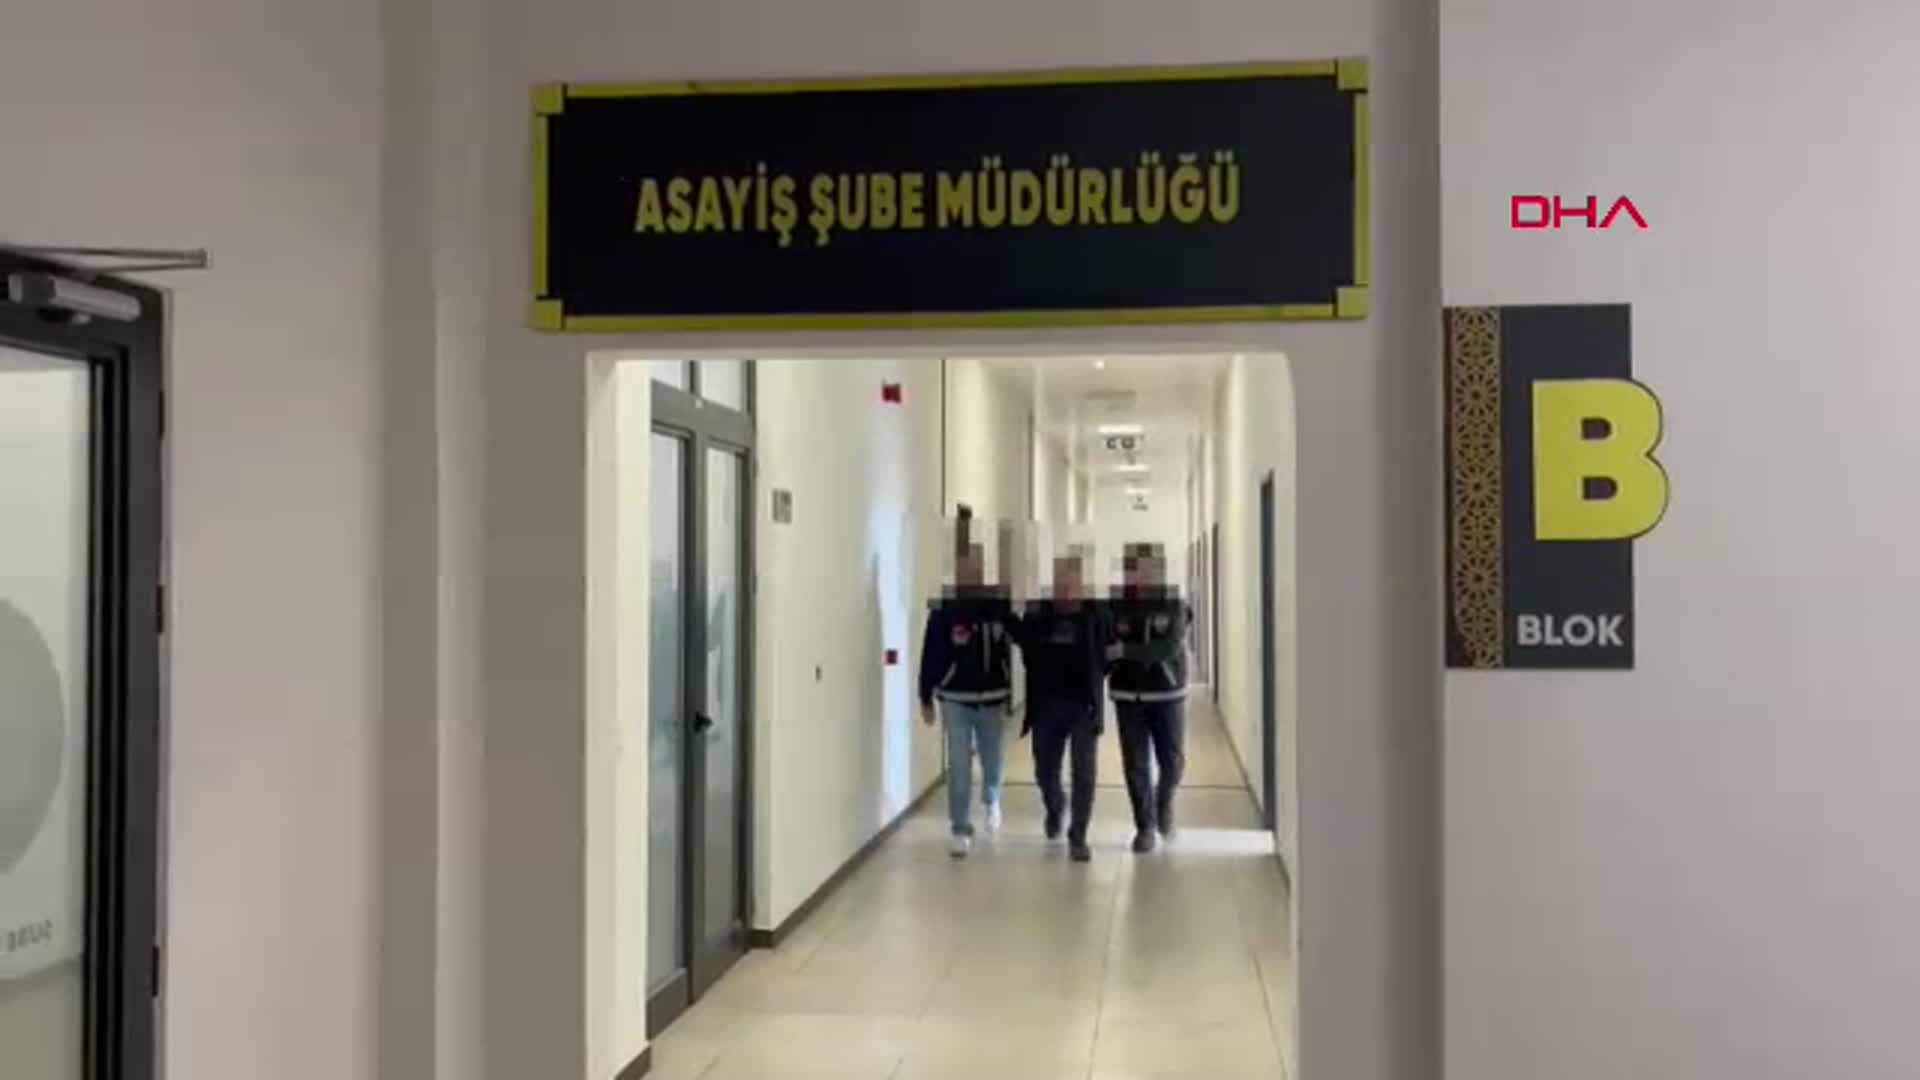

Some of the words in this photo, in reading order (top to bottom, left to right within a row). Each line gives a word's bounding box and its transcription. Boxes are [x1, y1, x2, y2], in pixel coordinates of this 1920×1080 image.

[635, 162, 798, 246] ASAYİŞ
[809, 172, 925, 246] ŞUBE
[937, 150, 1240, 228] MÜDÜRLÜĞÜ
[1531, 378, 1669, 540] B
[1516, 614, 1624, 647] BLOK
